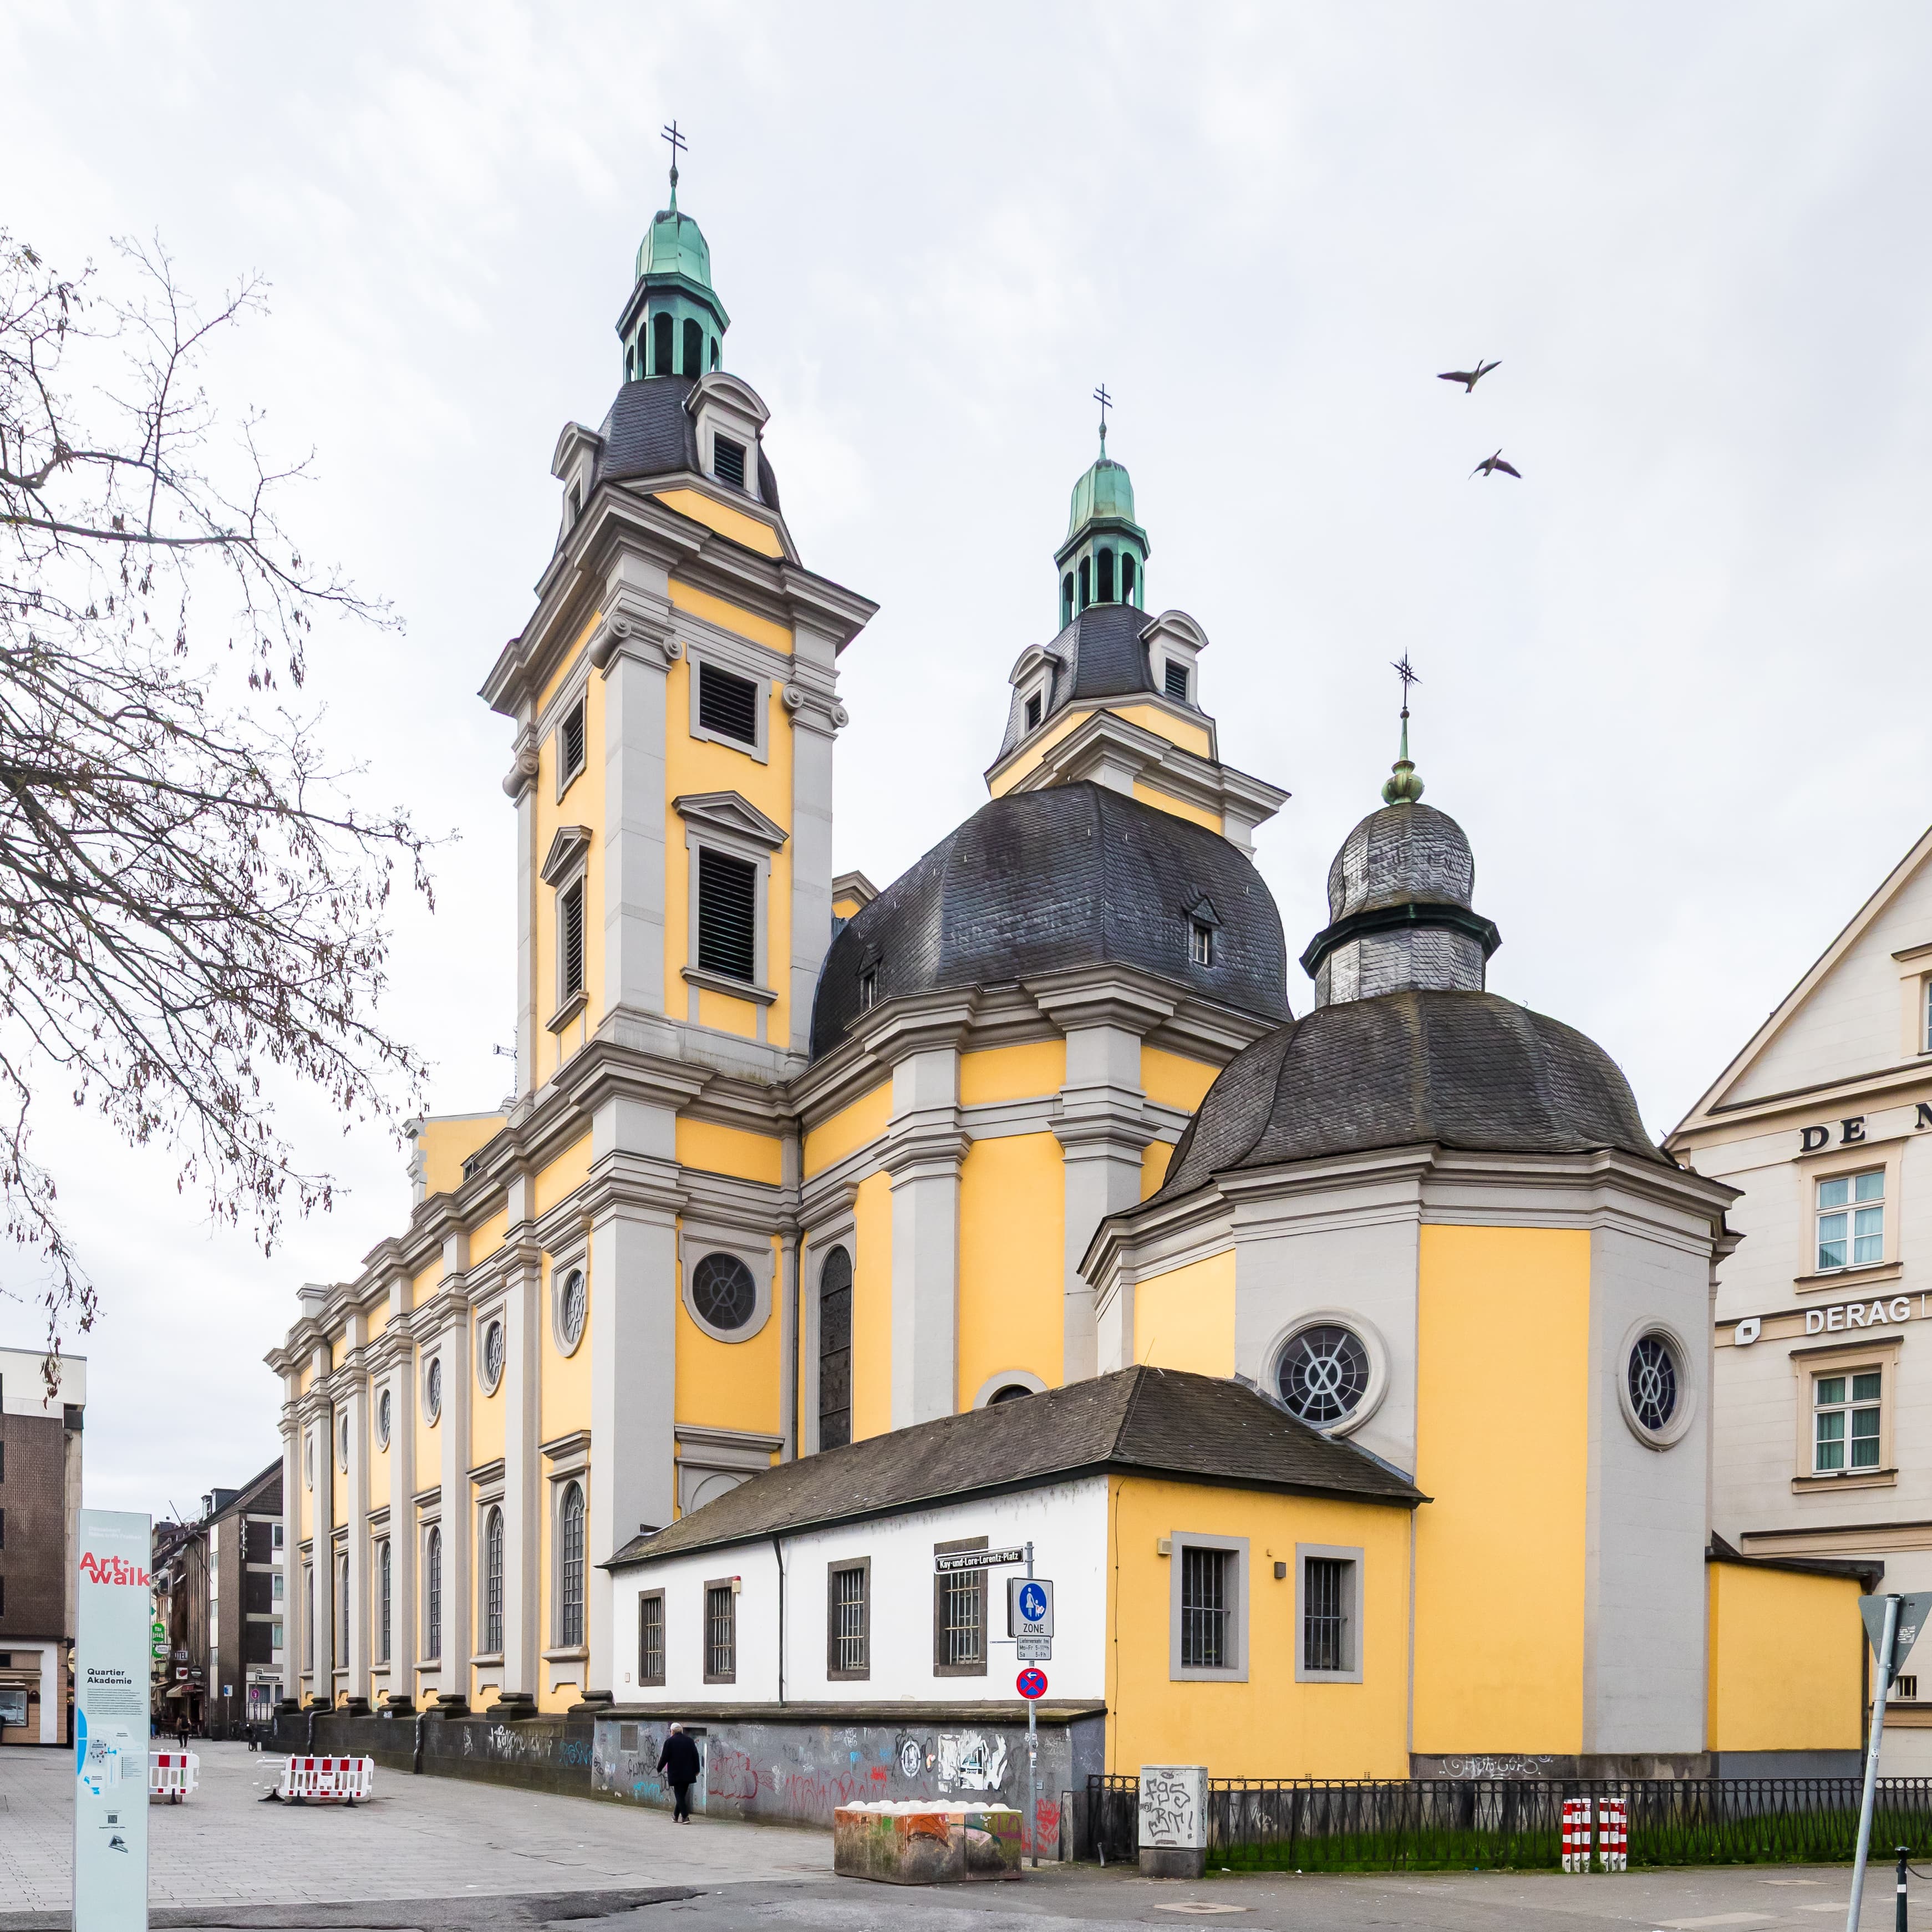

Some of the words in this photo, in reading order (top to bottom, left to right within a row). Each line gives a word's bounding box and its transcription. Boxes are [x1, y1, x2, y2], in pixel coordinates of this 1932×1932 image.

[1800, 1116, 1865, 1152] DE
[1806, 1297, 1910, 1335] DERAG
[89, 1567, 150, 1587] walk
[1023, 1623, 1044, 1634] ZONE
[87, 1676, 132, 1685] Akademie
